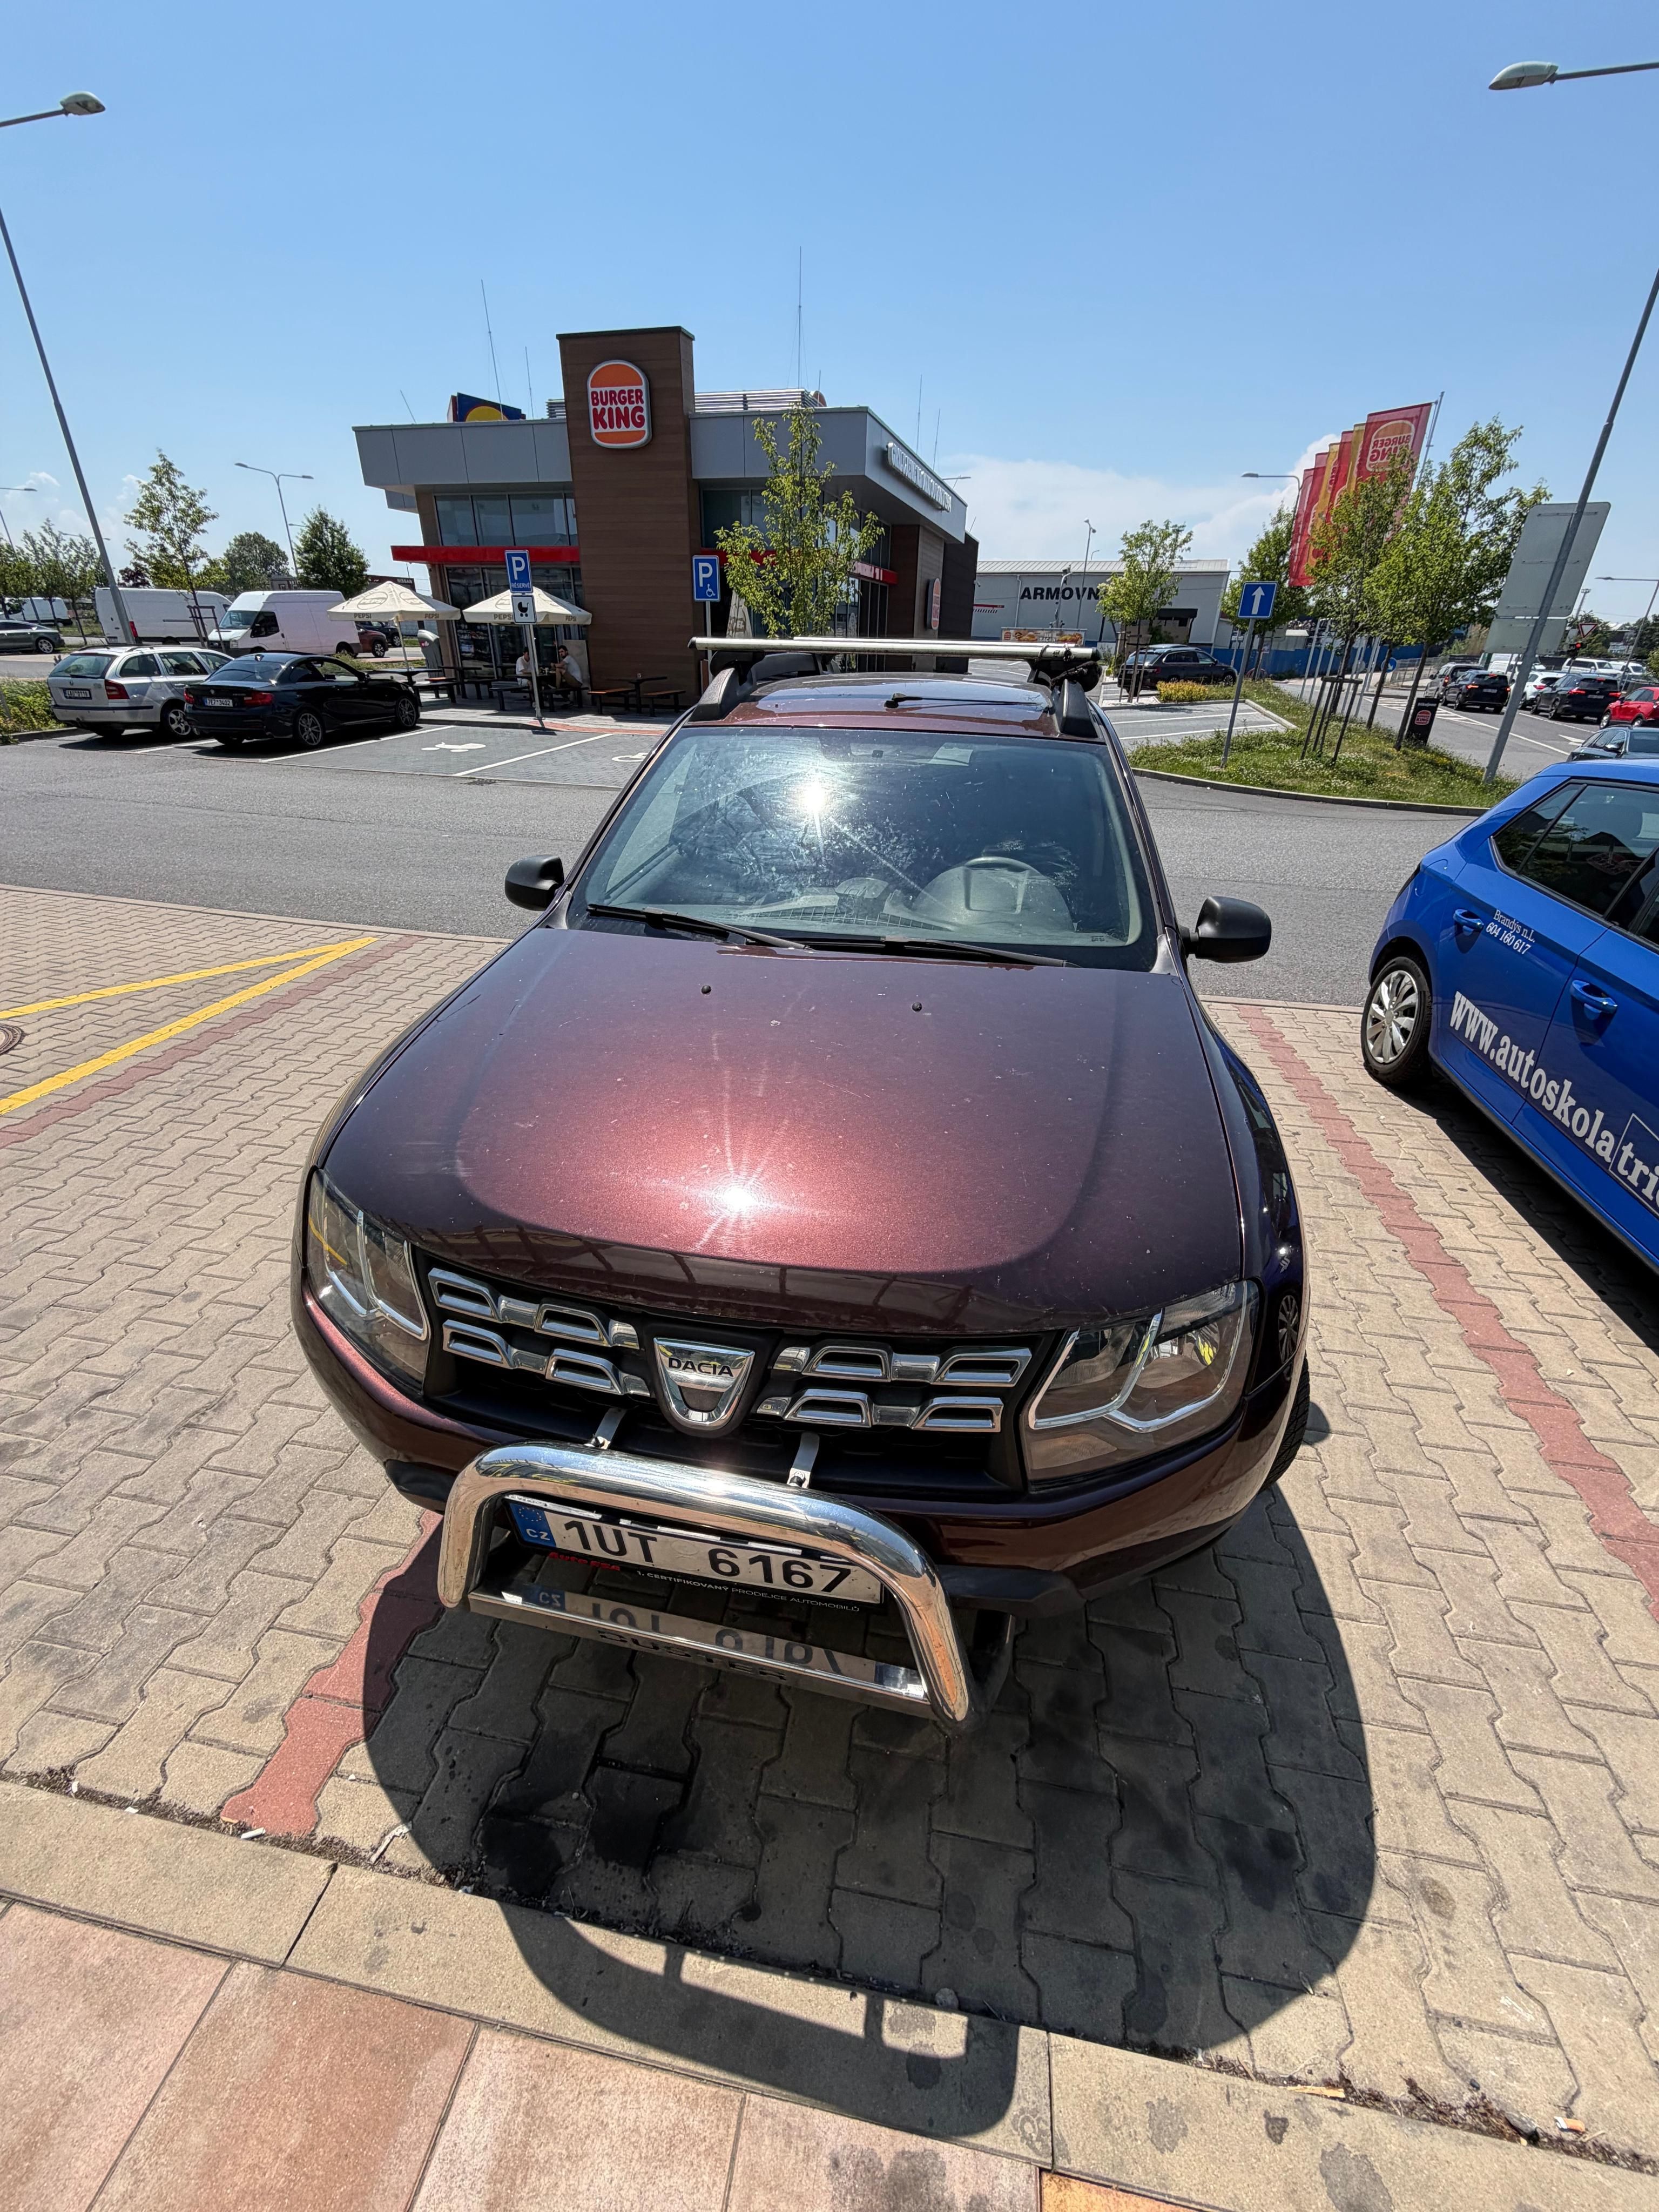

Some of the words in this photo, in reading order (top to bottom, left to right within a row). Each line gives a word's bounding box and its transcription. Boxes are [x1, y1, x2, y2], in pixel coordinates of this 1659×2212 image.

[591, 389, 644, 406] BURGER
[592, 406, 645, 430] KING
[511, 556, 525, 580] P
[698, 562, 713, 587] P
[1020, 587, 1102, 601] ARMOVN
[1493, 909, 1522, 934] Brandýs
[1486, 922, 1501, 938] 604
[1499, 930, 1515, 946] 160
[1513, 939, 1532, 955] 617
[668, 1357, 734, 1377] DACIA
[526, 1528, 550, 1541] CZ
[564, 1520, 657, 1563] 1UT
[708, 1548, 852, 1593] 6167
[646, 1572, 729, 1591] CERTIFIKOVANÝ
